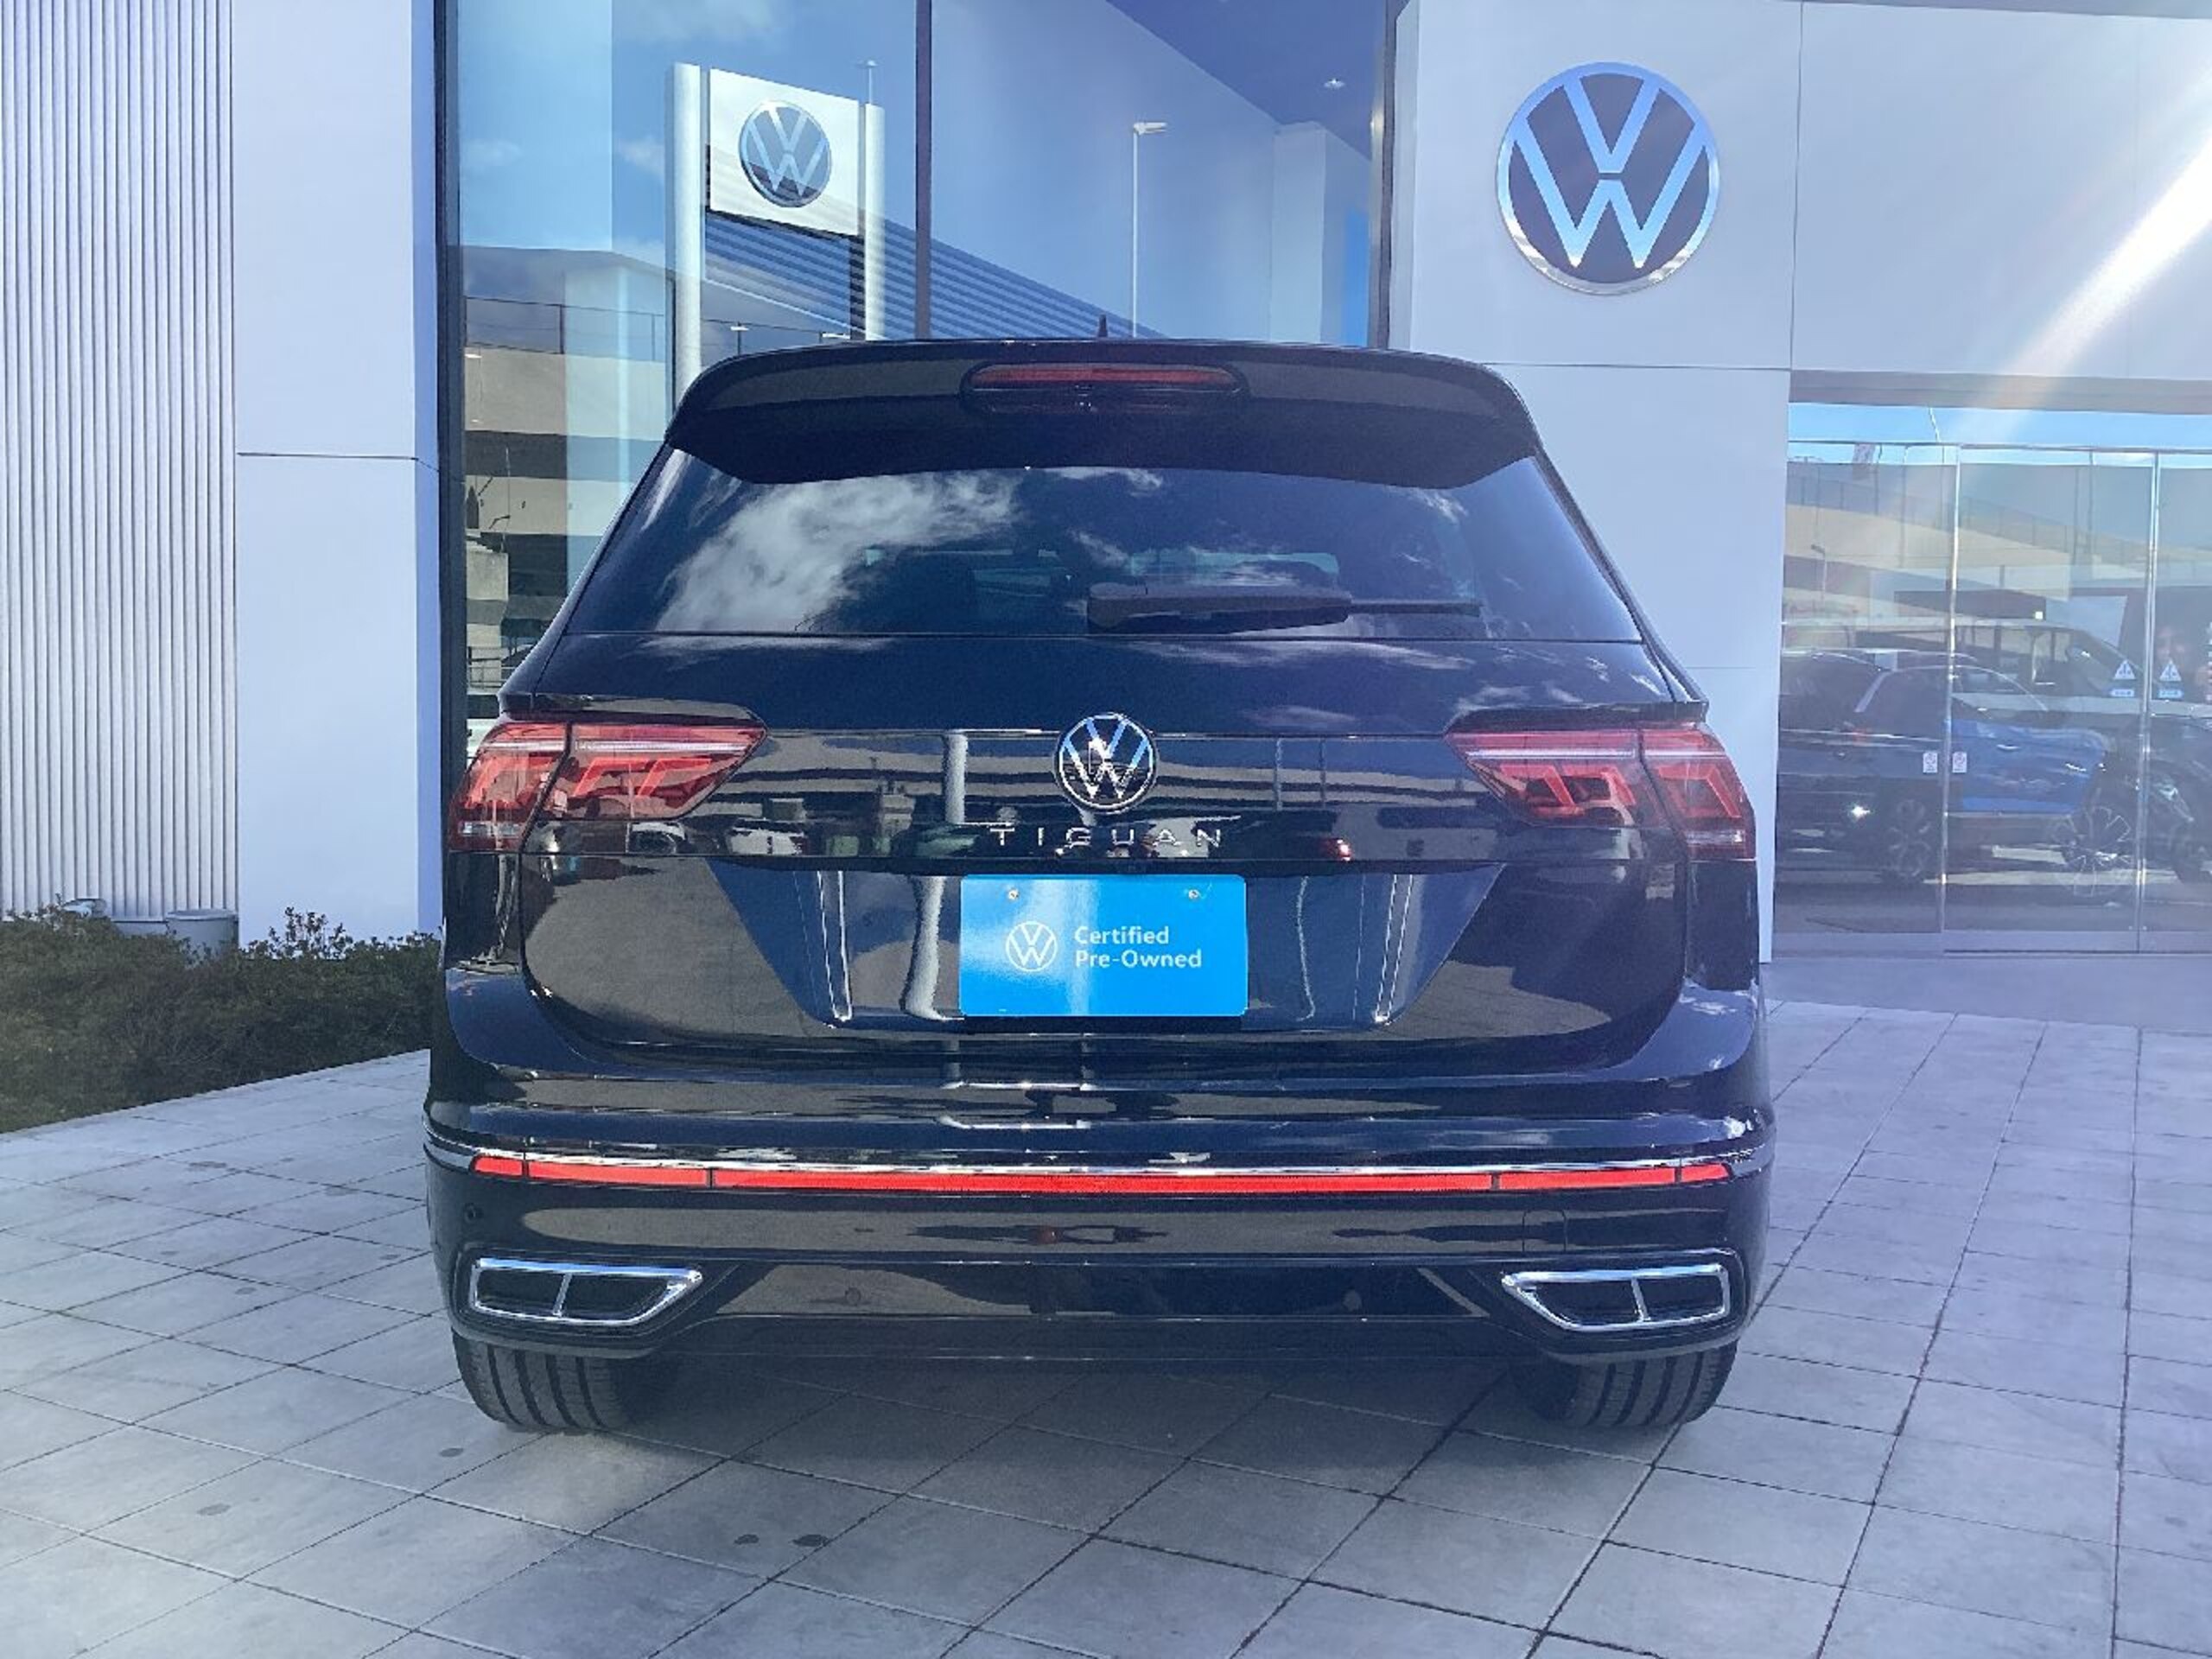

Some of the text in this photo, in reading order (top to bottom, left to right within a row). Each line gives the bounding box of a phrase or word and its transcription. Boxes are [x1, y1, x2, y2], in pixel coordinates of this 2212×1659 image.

[743, 102, 830, 199] VW
[1504, 69, 1713, 275] VW
[1060, 715, 1154, 804] VW
[989, 827, 1222, 848] TIGUAN
[1007, 923, 1056, 968] VW
[1074, 925, 1170, 945] Certified
[1075, 949, 1203, 969] Pre-Owned
